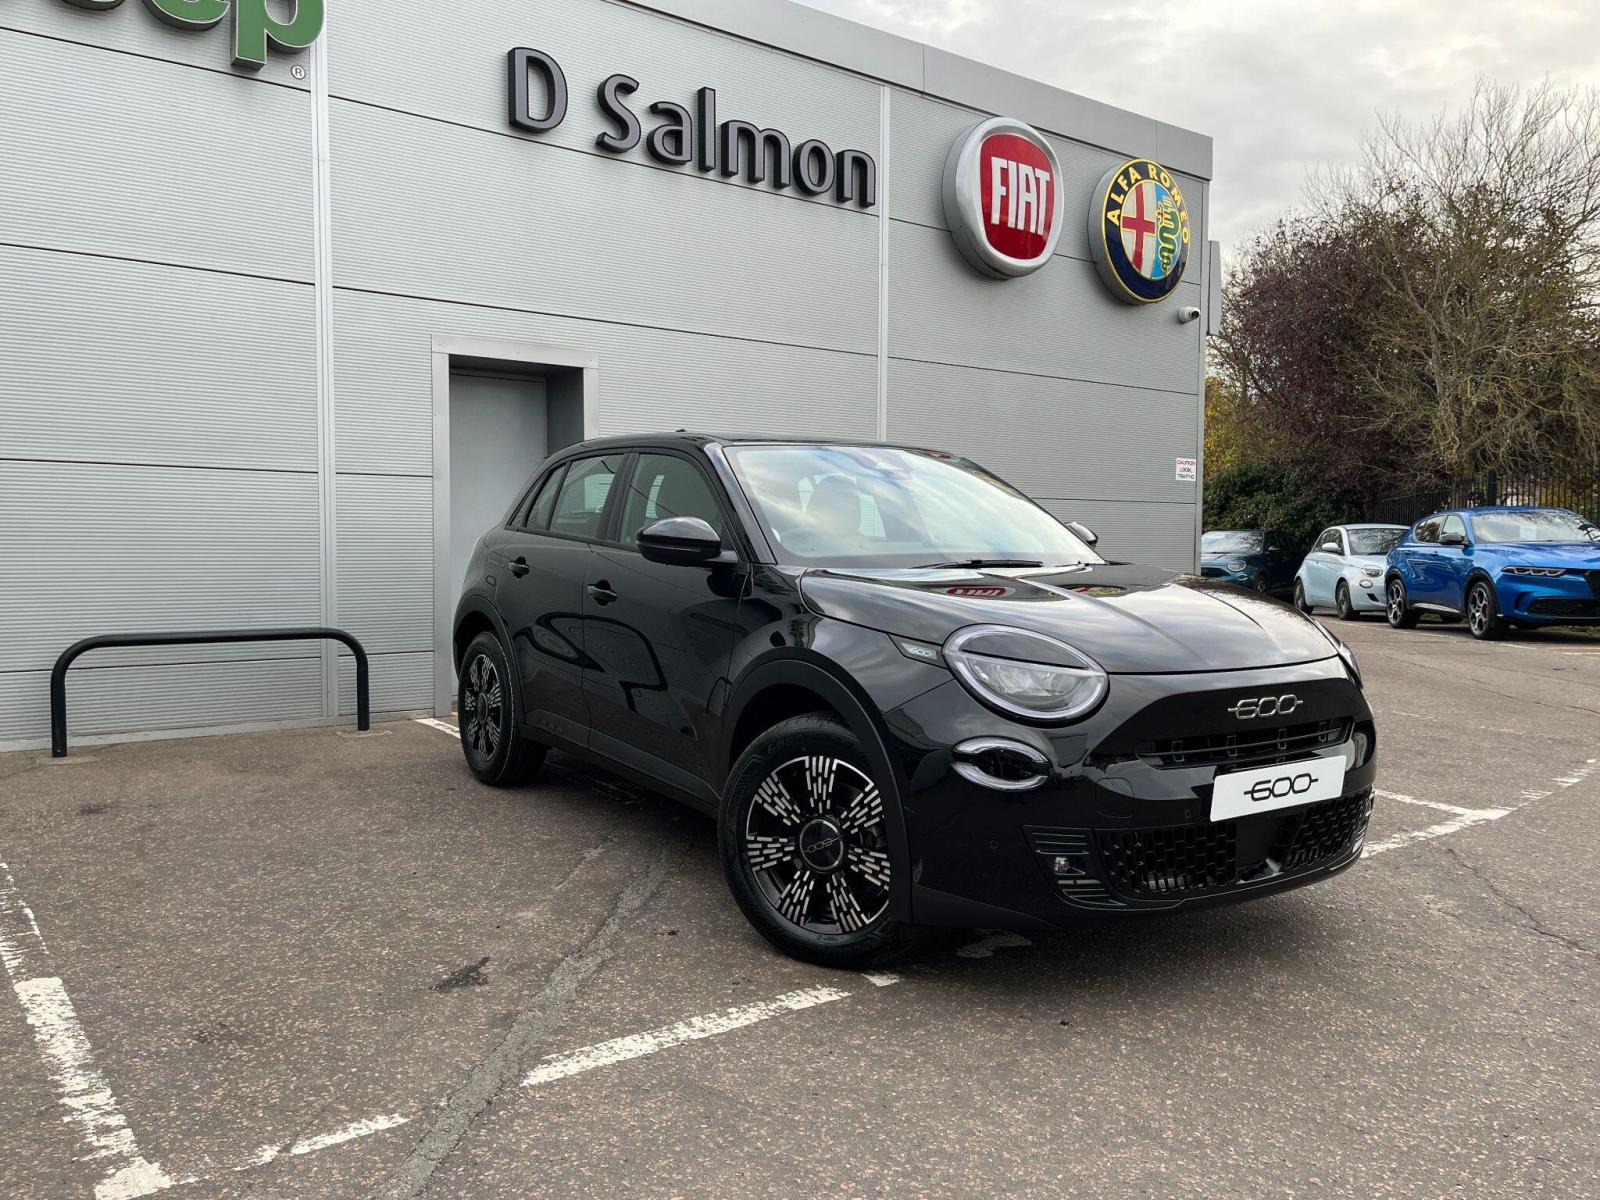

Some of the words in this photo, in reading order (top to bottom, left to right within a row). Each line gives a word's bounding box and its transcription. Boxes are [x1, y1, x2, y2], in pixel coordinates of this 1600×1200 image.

[508, 47, 568, 133] D
[596, 74, 876, 208] Salmon
[990, 156, 1050, 236] FIAT
[1107, 169, 1141, 227] ALFA
[1148, 163, 1191, 245] ROMEO
